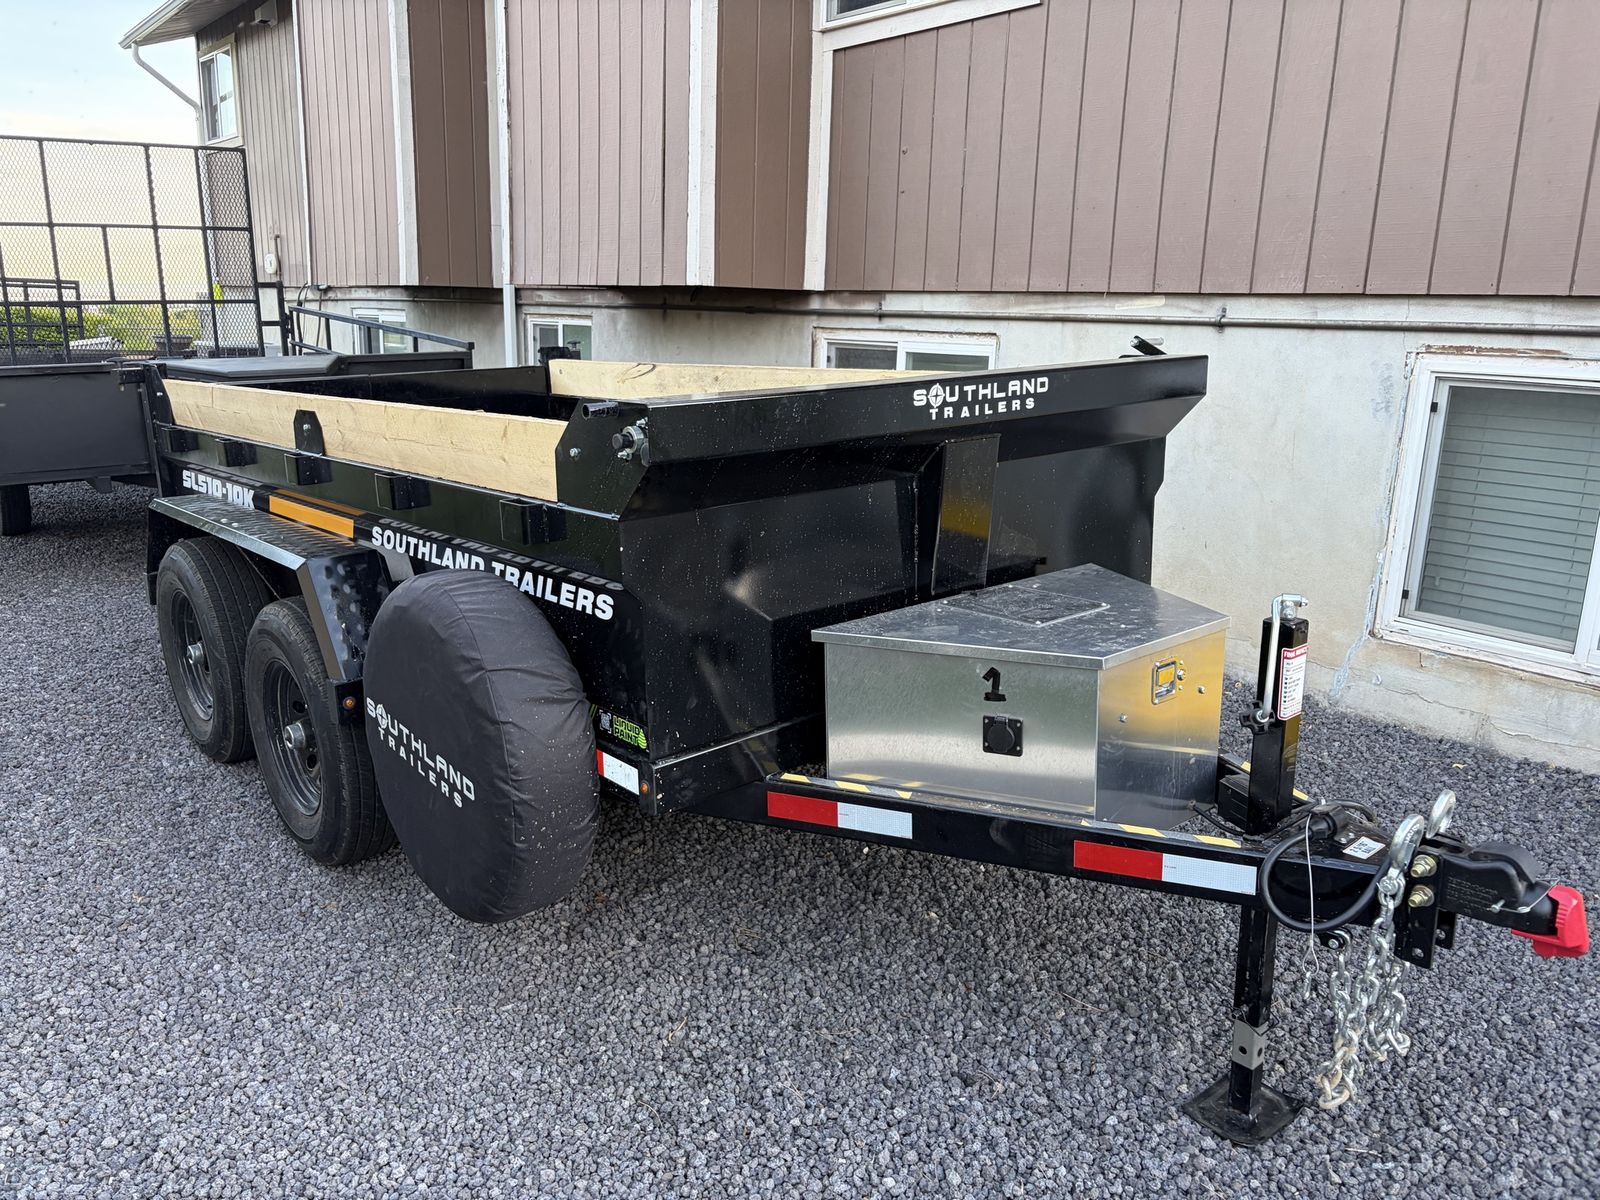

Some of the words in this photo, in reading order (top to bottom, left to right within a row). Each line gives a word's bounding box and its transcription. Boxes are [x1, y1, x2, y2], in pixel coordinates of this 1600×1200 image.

[913, 376, 1049, 407] SOUTHLAND
[929, 398, 1035, 420] TRAILERS
[182, 469, 255, 510] SL510-10K
[371, 526, 485, 571] SOUTHLAND
[491, 560, 615, 621] TRAILERS
[982, 666, 1007, 702] 1
[366, 697, 475, 801] SOUTHLAND
[378, 726, 463, 808] TRAILERS
